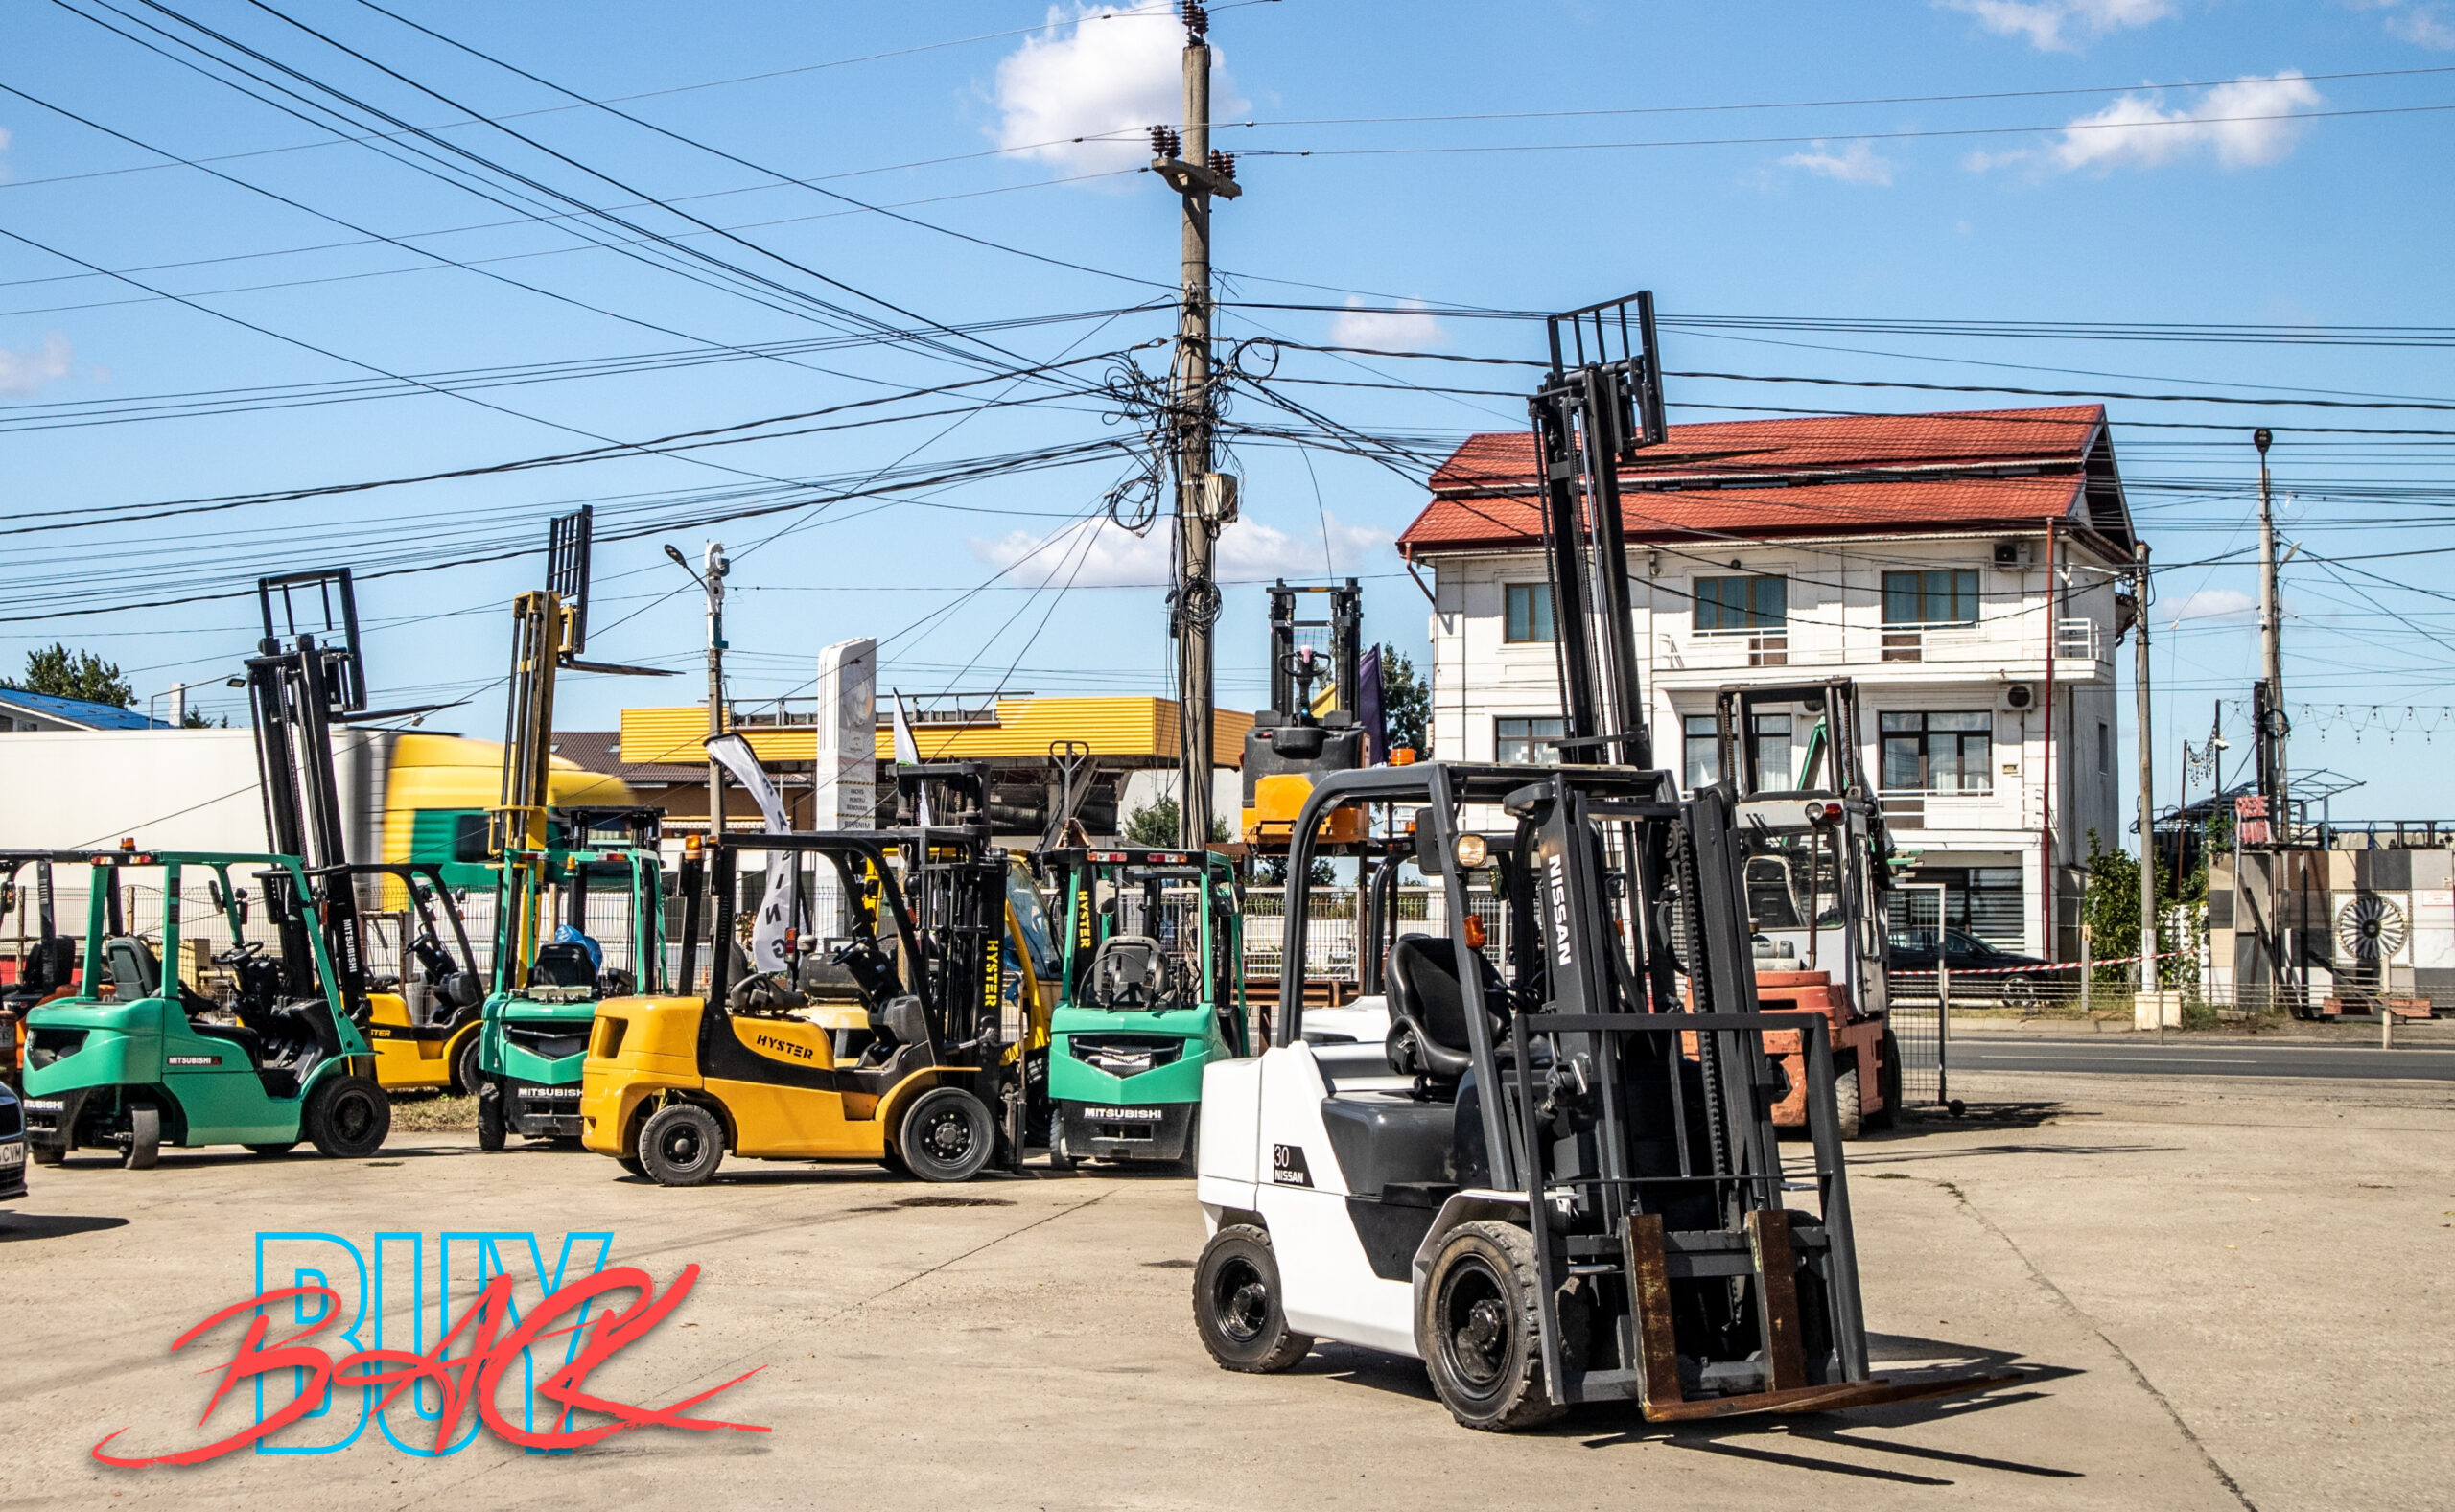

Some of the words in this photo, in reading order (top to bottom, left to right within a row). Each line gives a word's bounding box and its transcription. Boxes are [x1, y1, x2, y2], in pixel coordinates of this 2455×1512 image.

[1078, 890, 1092, 949] HYSTER
[1549, 853, 1572, 966] NISSAN
[343, 919, 358, 973] MITSUBISHI
[984, 940, 999, 1007] HYSTER
[370, 1028, 392, 1038] TER
[756, 1034, 814, 1060] HYSTER
[168, 1057, 212, 1065] MITSUBISHI
[518, 1087, 583, 1098] MITSUBISH
[1084, 1107, 1162, 1120] MITSUBISHI
[1274, 1145, 1290, 1168] 30
[1274, 1169, 1304, 1184] NISSAN
